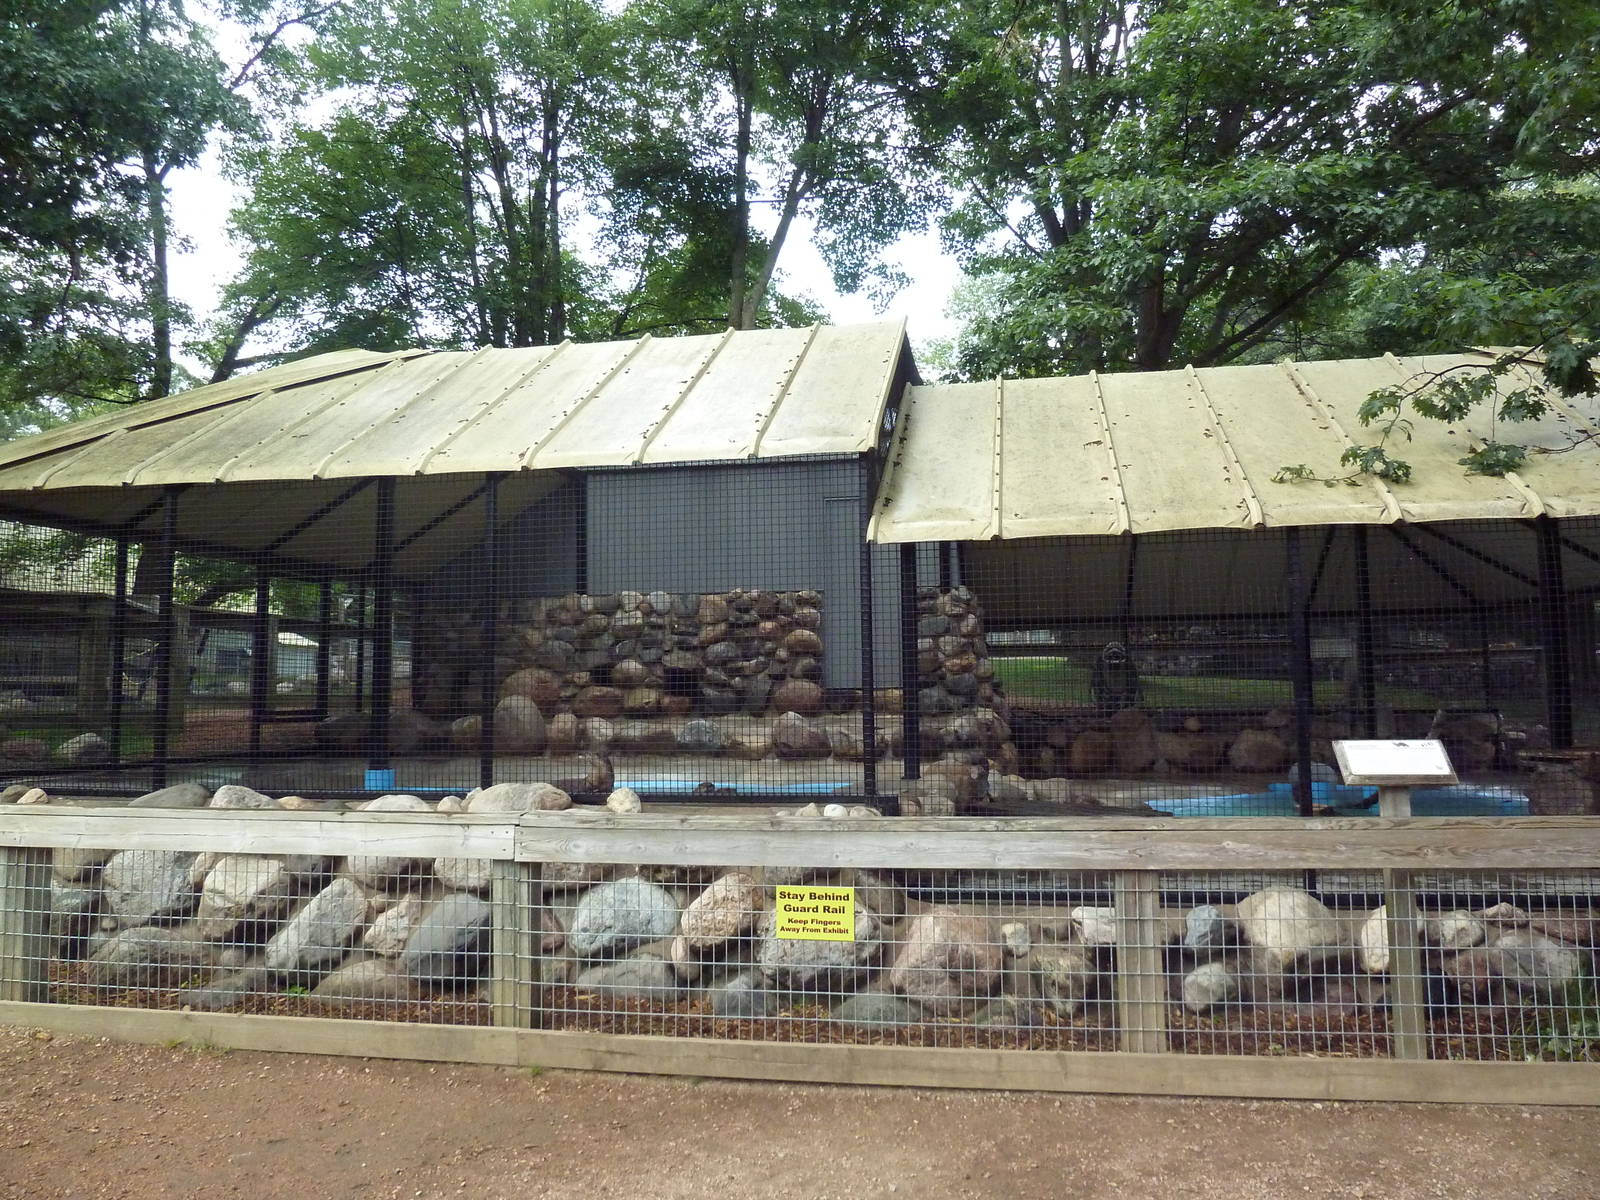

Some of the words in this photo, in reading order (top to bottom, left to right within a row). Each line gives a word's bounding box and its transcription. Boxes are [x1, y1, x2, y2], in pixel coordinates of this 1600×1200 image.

[779, 891, 805, 901] Stay
[809, 892, 850, 901] Behind
[783, 904, 819, 913] Guard
[823, 905, 846, 914] Rail
